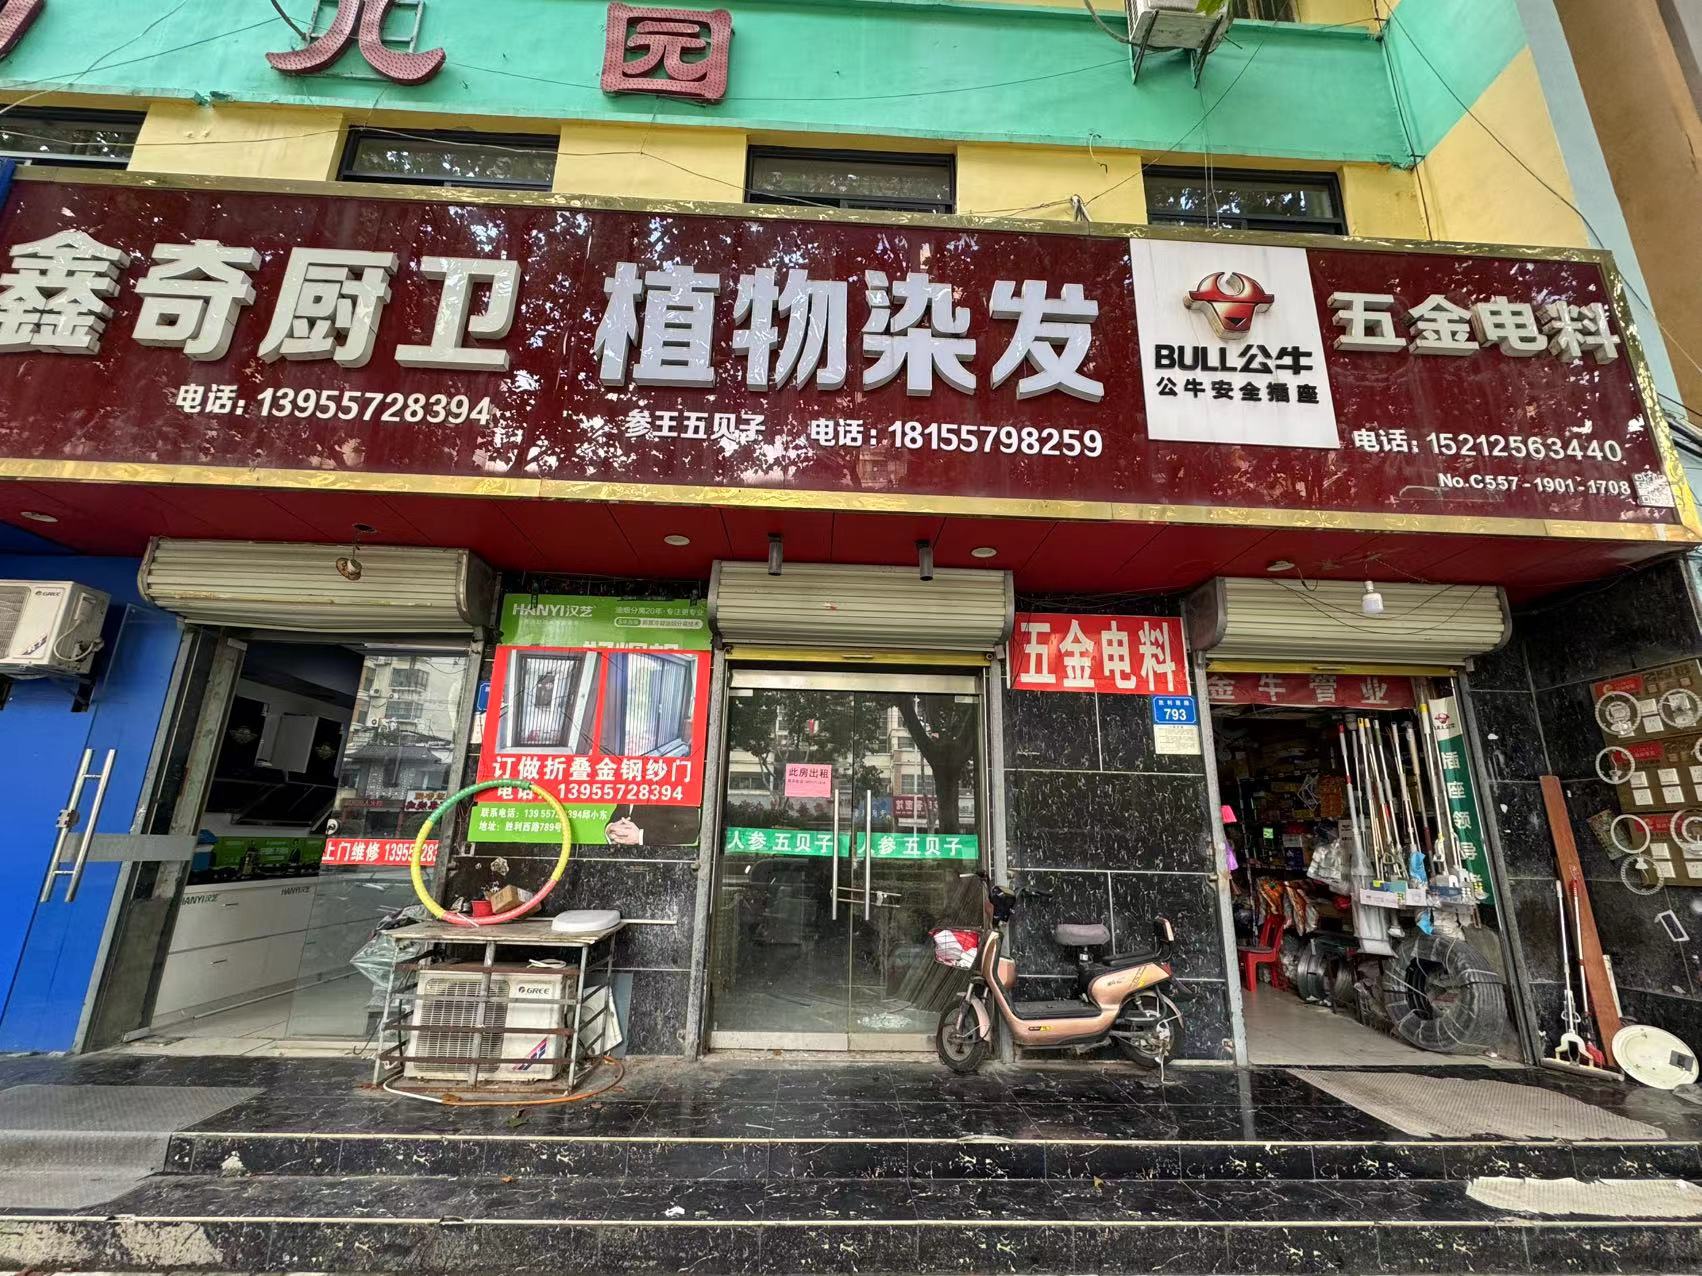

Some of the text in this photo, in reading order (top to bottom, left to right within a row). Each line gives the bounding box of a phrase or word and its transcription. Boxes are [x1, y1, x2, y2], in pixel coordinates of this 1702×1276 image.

[0, 229, 521, 372] 鑫奇厨卫
[595, 261, 1104, 403] 植物染发
[1327, 291, 1621, 364] 五金电料
[1156, 376, 1319, 404] 公牛安全插座
[625, 409, 766, 442] 参王五贝子
[1020, 619, 1176, 692] 五金电料
[1163, 708, 1187, 721] 793
[493, 757, 692, 782] 订做折叠金钢纱门
[789, 767, 829, 779] 此房出租
[322, 841, 380, 862] 上门维修
[728, 831, 834, 851] 人参五贝子
